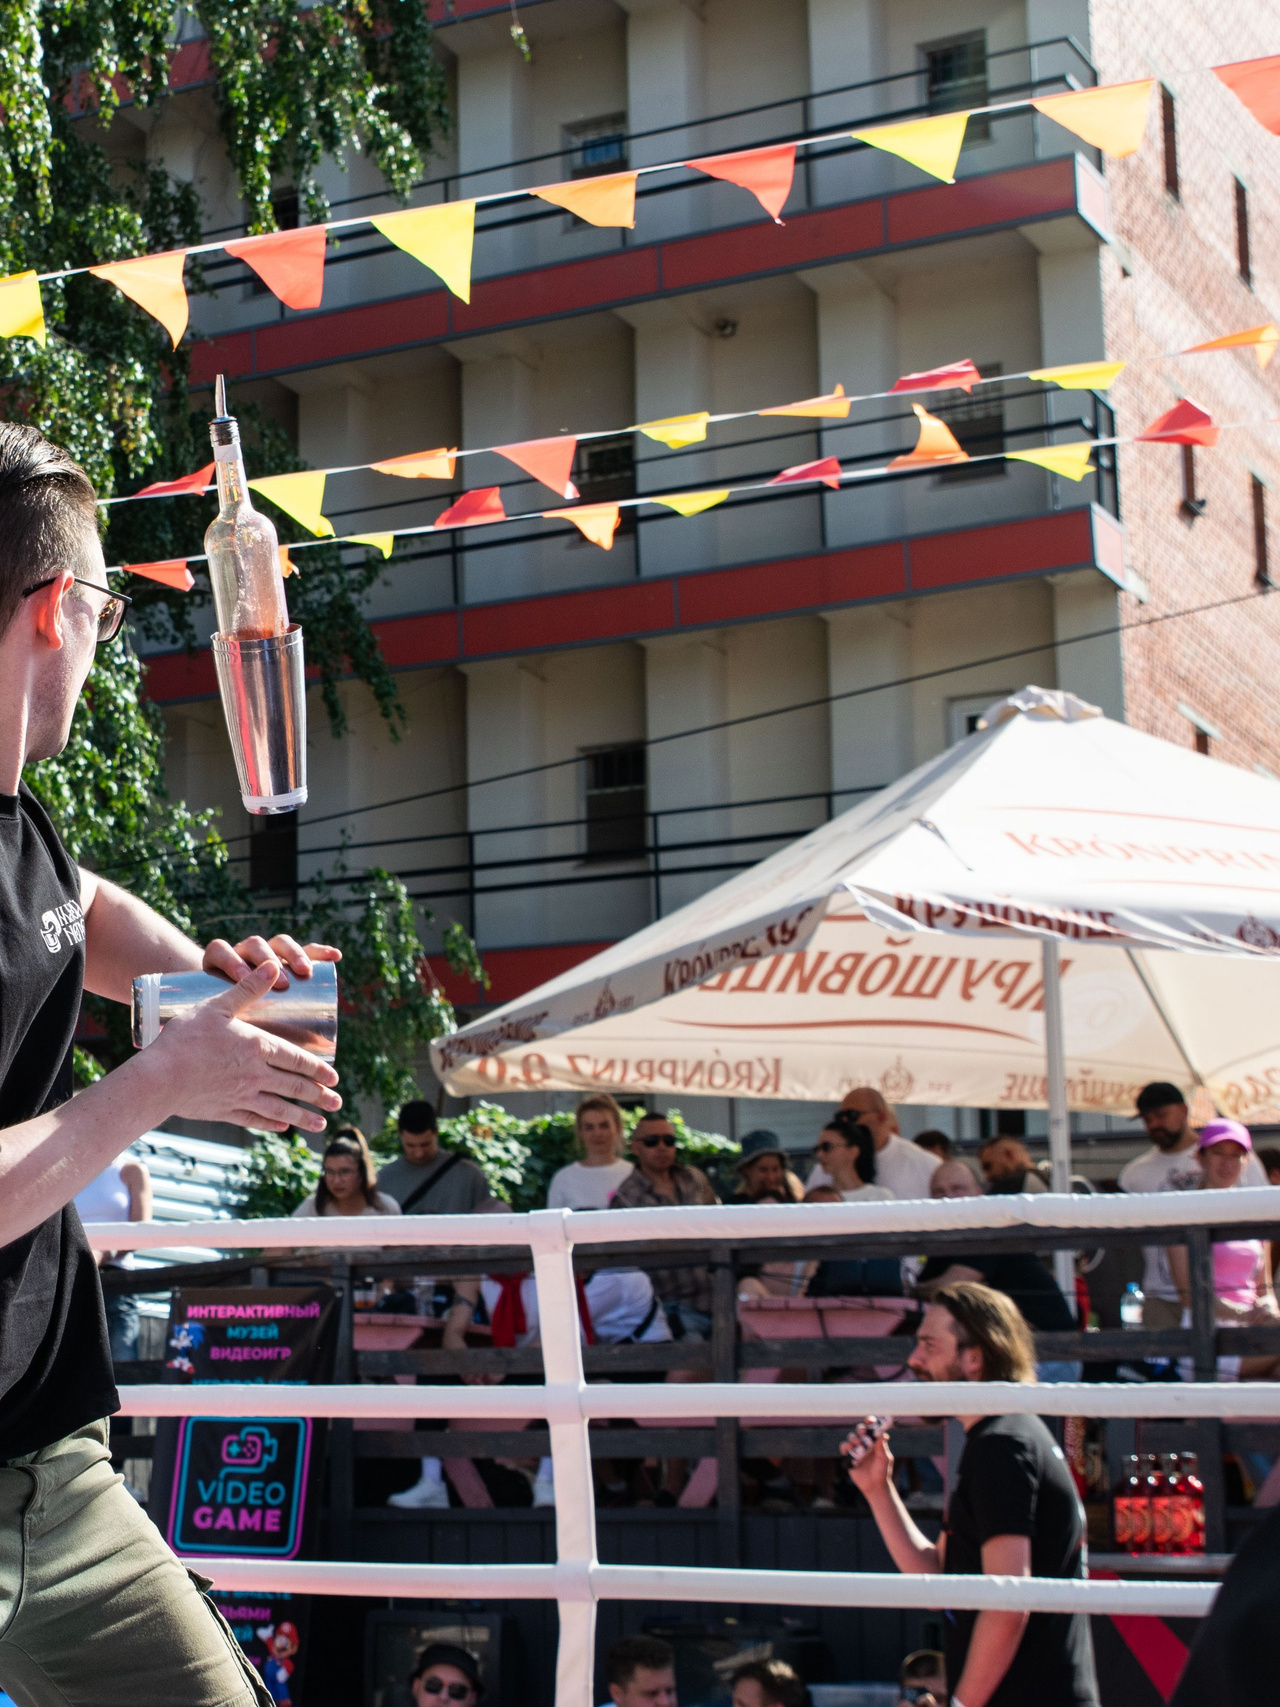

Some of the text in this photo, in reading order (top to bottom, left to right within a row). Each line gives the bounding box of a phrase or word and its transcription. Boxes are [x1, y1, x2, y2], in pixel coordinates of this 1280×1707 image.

[186, 1301, 320, 1319] ИНТЕРАКТИВНЫЙ
[226, 1323, 280, 1340] МУЗЕЙ
[210, 1346, 291, 1362] ВИДЕОИГР
[197, 1479, 286, 1506] VIDEO
[193, 1507, 282, 1532] GAME
